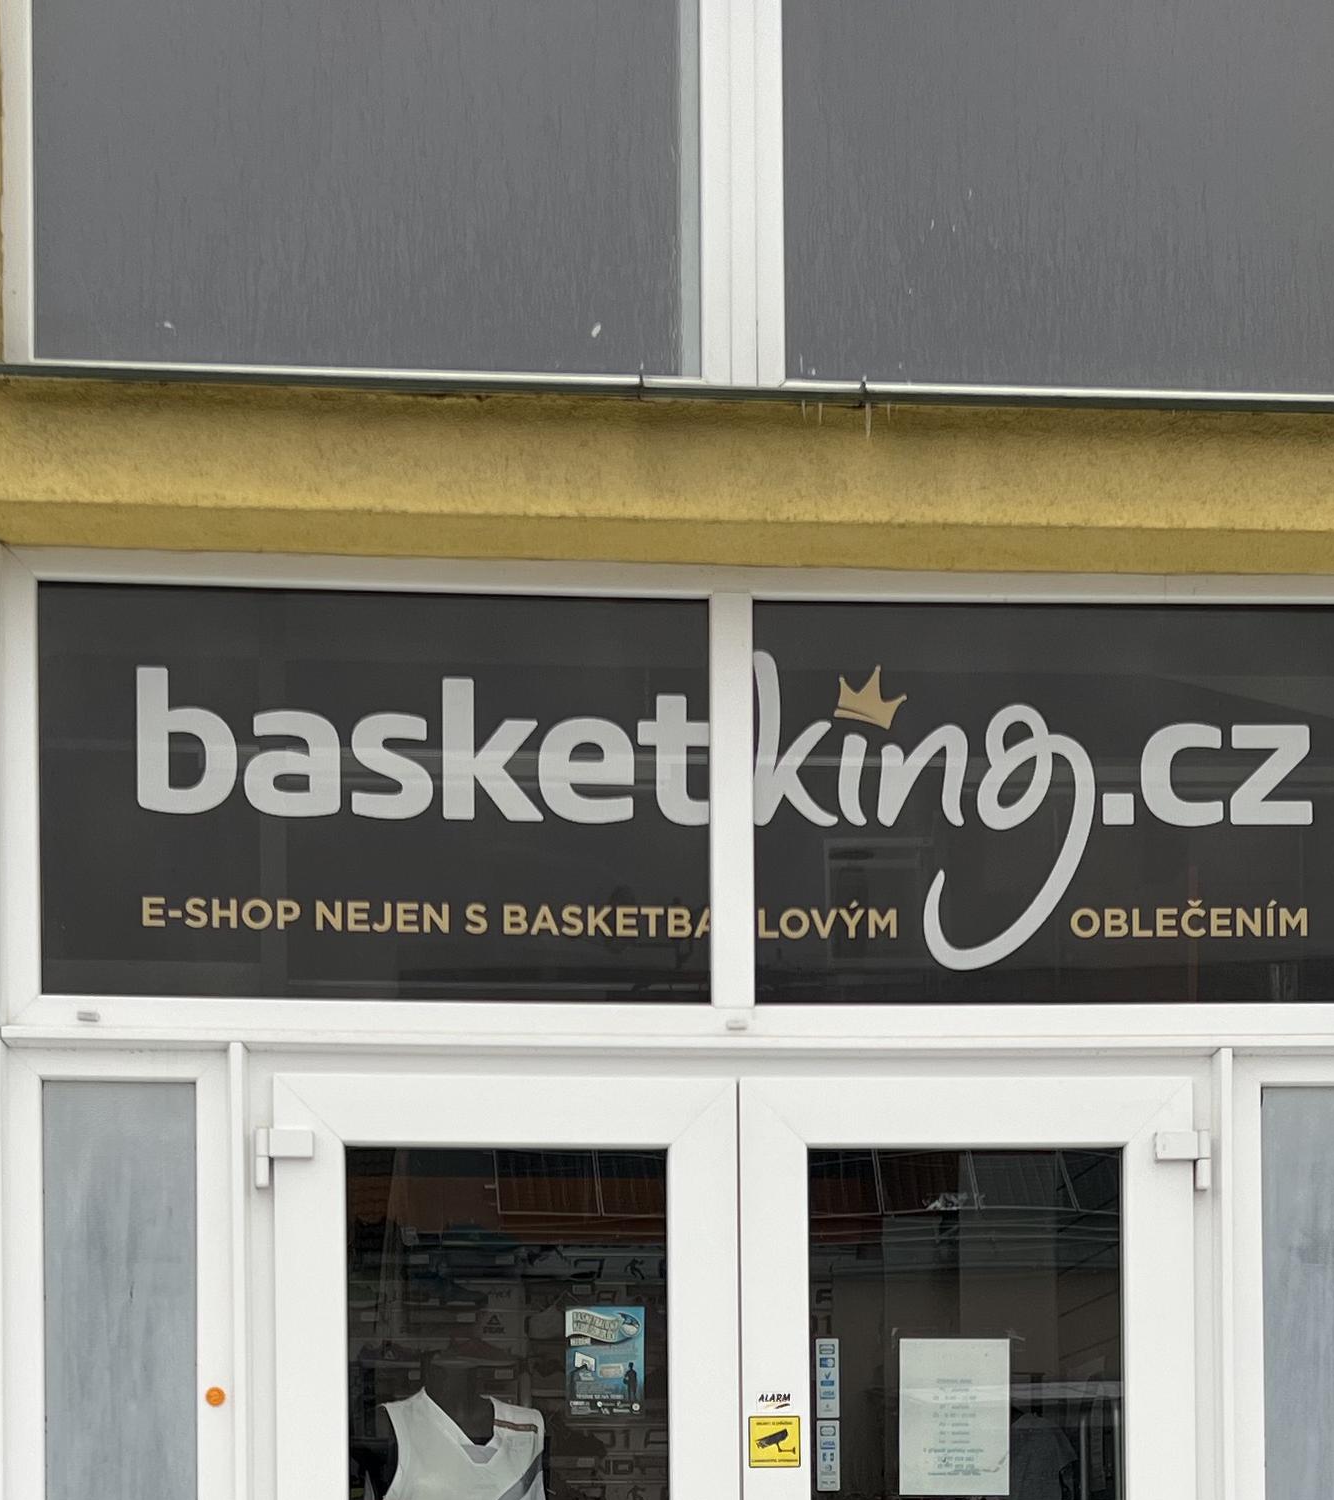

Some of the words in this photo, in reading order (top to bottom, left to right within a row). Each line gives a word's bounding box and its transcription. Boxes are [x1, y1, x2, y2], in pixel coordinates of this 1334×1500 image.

[142, 895, 301, 931] E-SHOP
[315, 900, 451, 935] NEJEN
[465, 903, 489, 936] S
[503, 900, 898, 940] BASKETBALOVÝM
[1069, 899, 1309, 939] OBLEČENÍM
[758, 1393, 791, 1403] ALARM
